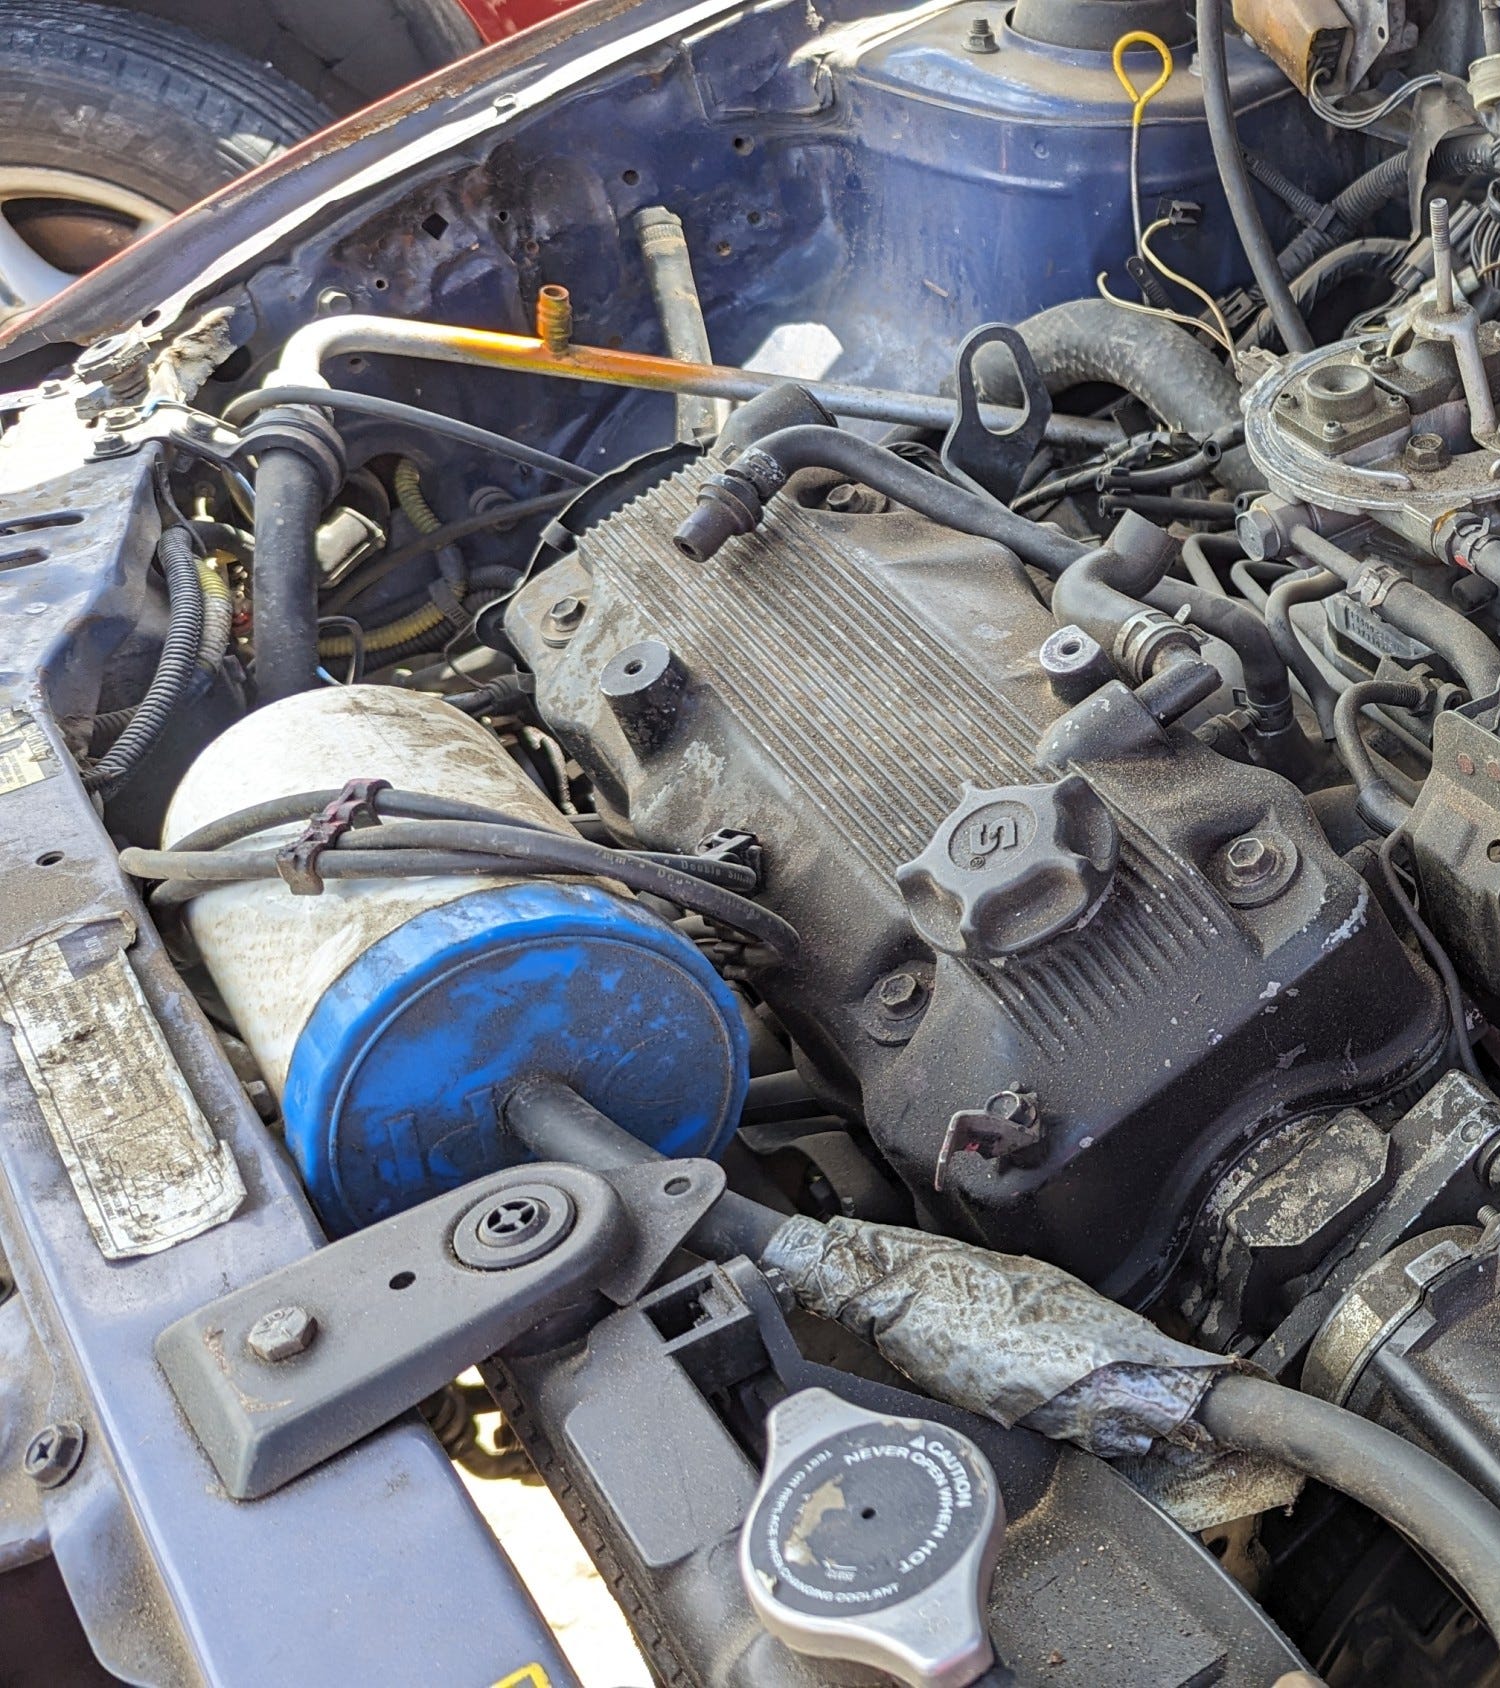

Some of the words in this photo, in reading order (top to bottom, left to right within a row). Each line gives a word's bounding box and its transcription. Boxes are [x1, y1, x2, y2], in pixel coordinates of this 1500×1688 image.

[843, 1445, 910, 1466] NEVER
[910, 1452, 949, 1487] OPEN
[927, 1440, 972, 1508] CAUTION
[930, 1486, 954, 1538] WHEN
[898, 1539, 938, 1574] HOT
